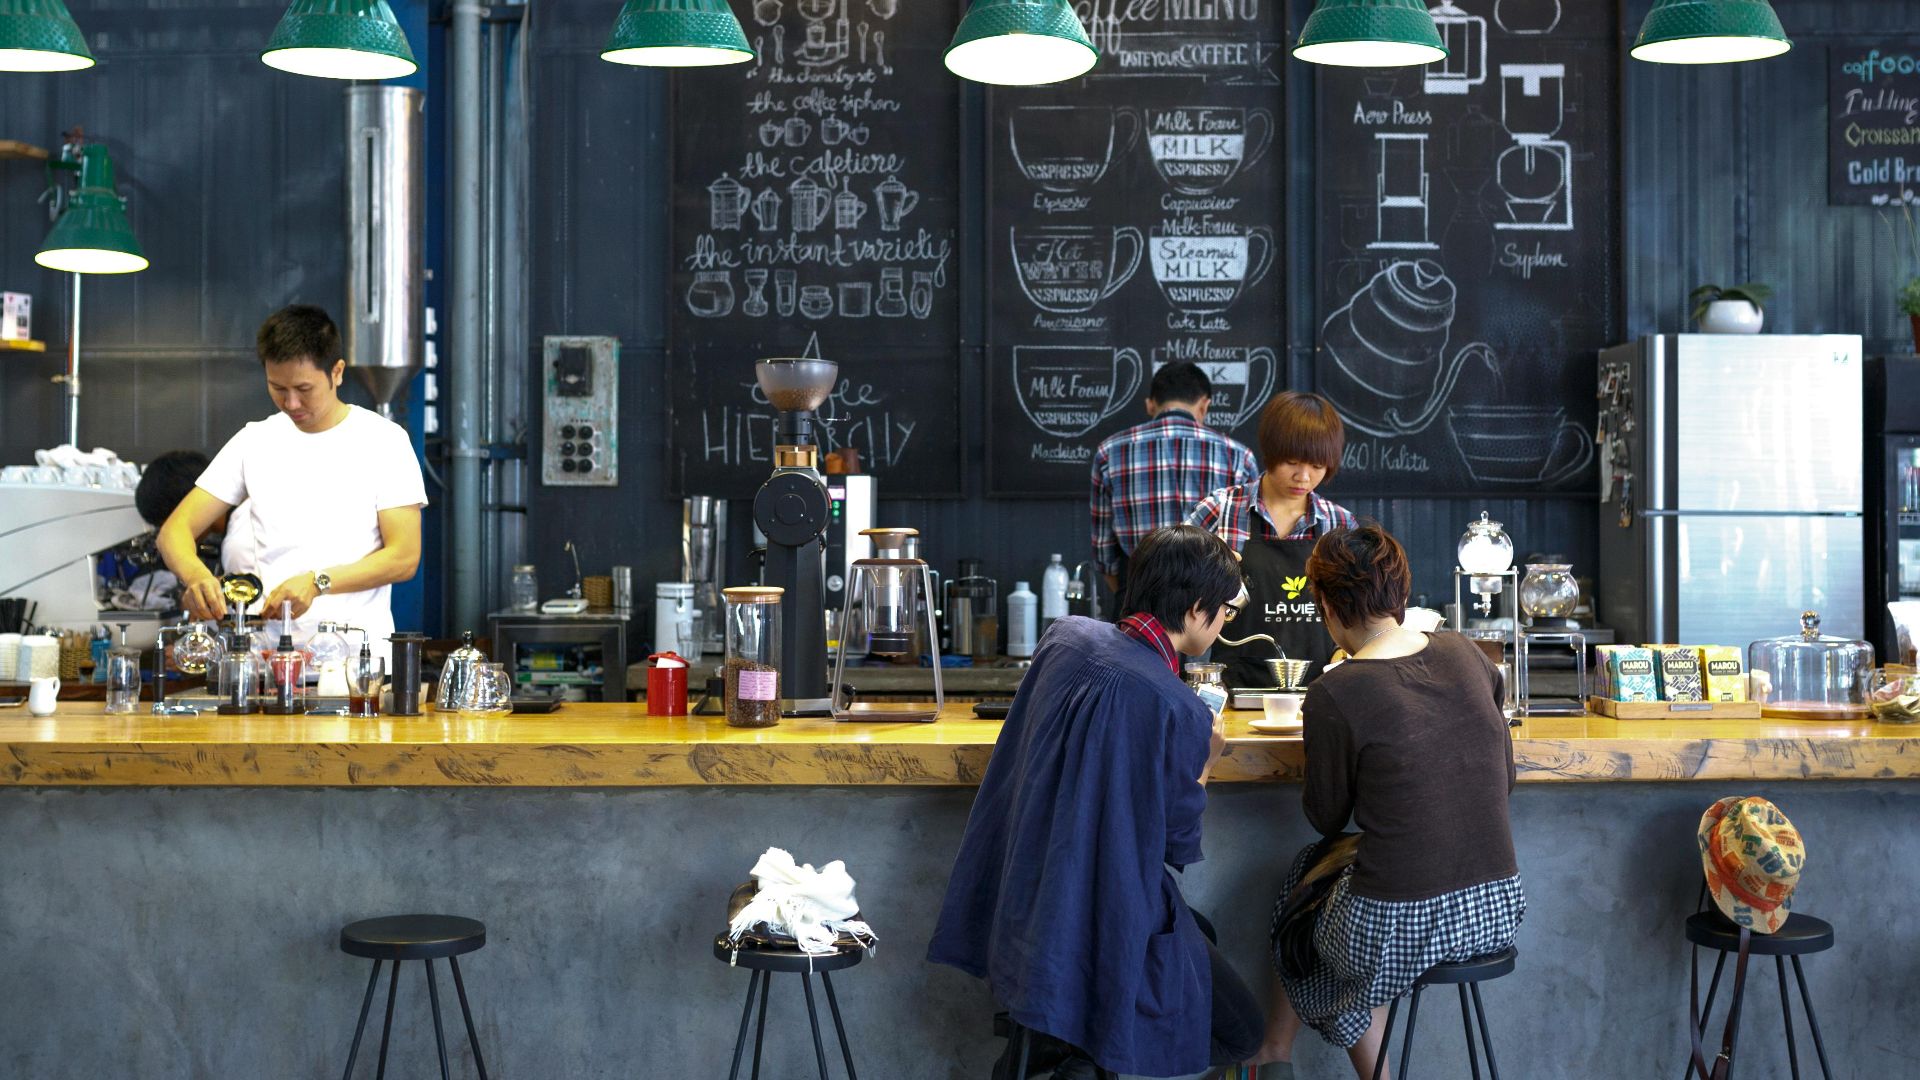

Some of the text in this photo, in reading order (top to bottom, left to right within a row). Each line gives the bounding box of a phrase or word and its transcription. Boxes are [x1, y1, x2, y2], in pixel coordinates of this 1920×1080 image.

[1178, 43, 1249, 68] COFFEE
[746, 86, 900, 118] the coffee siphon
[1155, 110, 1194, 131] Milk
[1392, 100, 1433, 126] Press
[1163, 138, 1232, 156] MILK
[740, 151, 786, 179] the
[1847, 157, 1891, 185] Cold
[1162, 216, 1200, 235] Milk
[685, 228, 951, 289] the instant variety
[1159, 239, 1238, 260] Steamed
[1021, 260, 1104, 280] WATER
[1165, 261, 1231, 279] MILK
[1499, 242, 1568, 280] Syphon
[1166, 338, 1202, 359] Milk
[1029, 374, 1112, 399] Milk Foam
[1034, 411, 1099, 426] ESPRESSO
[1381, 443, 1431, 472] Kalita
[1622, 661, 1649, 669] MAROU
[1667, 660, 1694, 669] MAROU
[1711, 661, 1738, 670] MAROU
